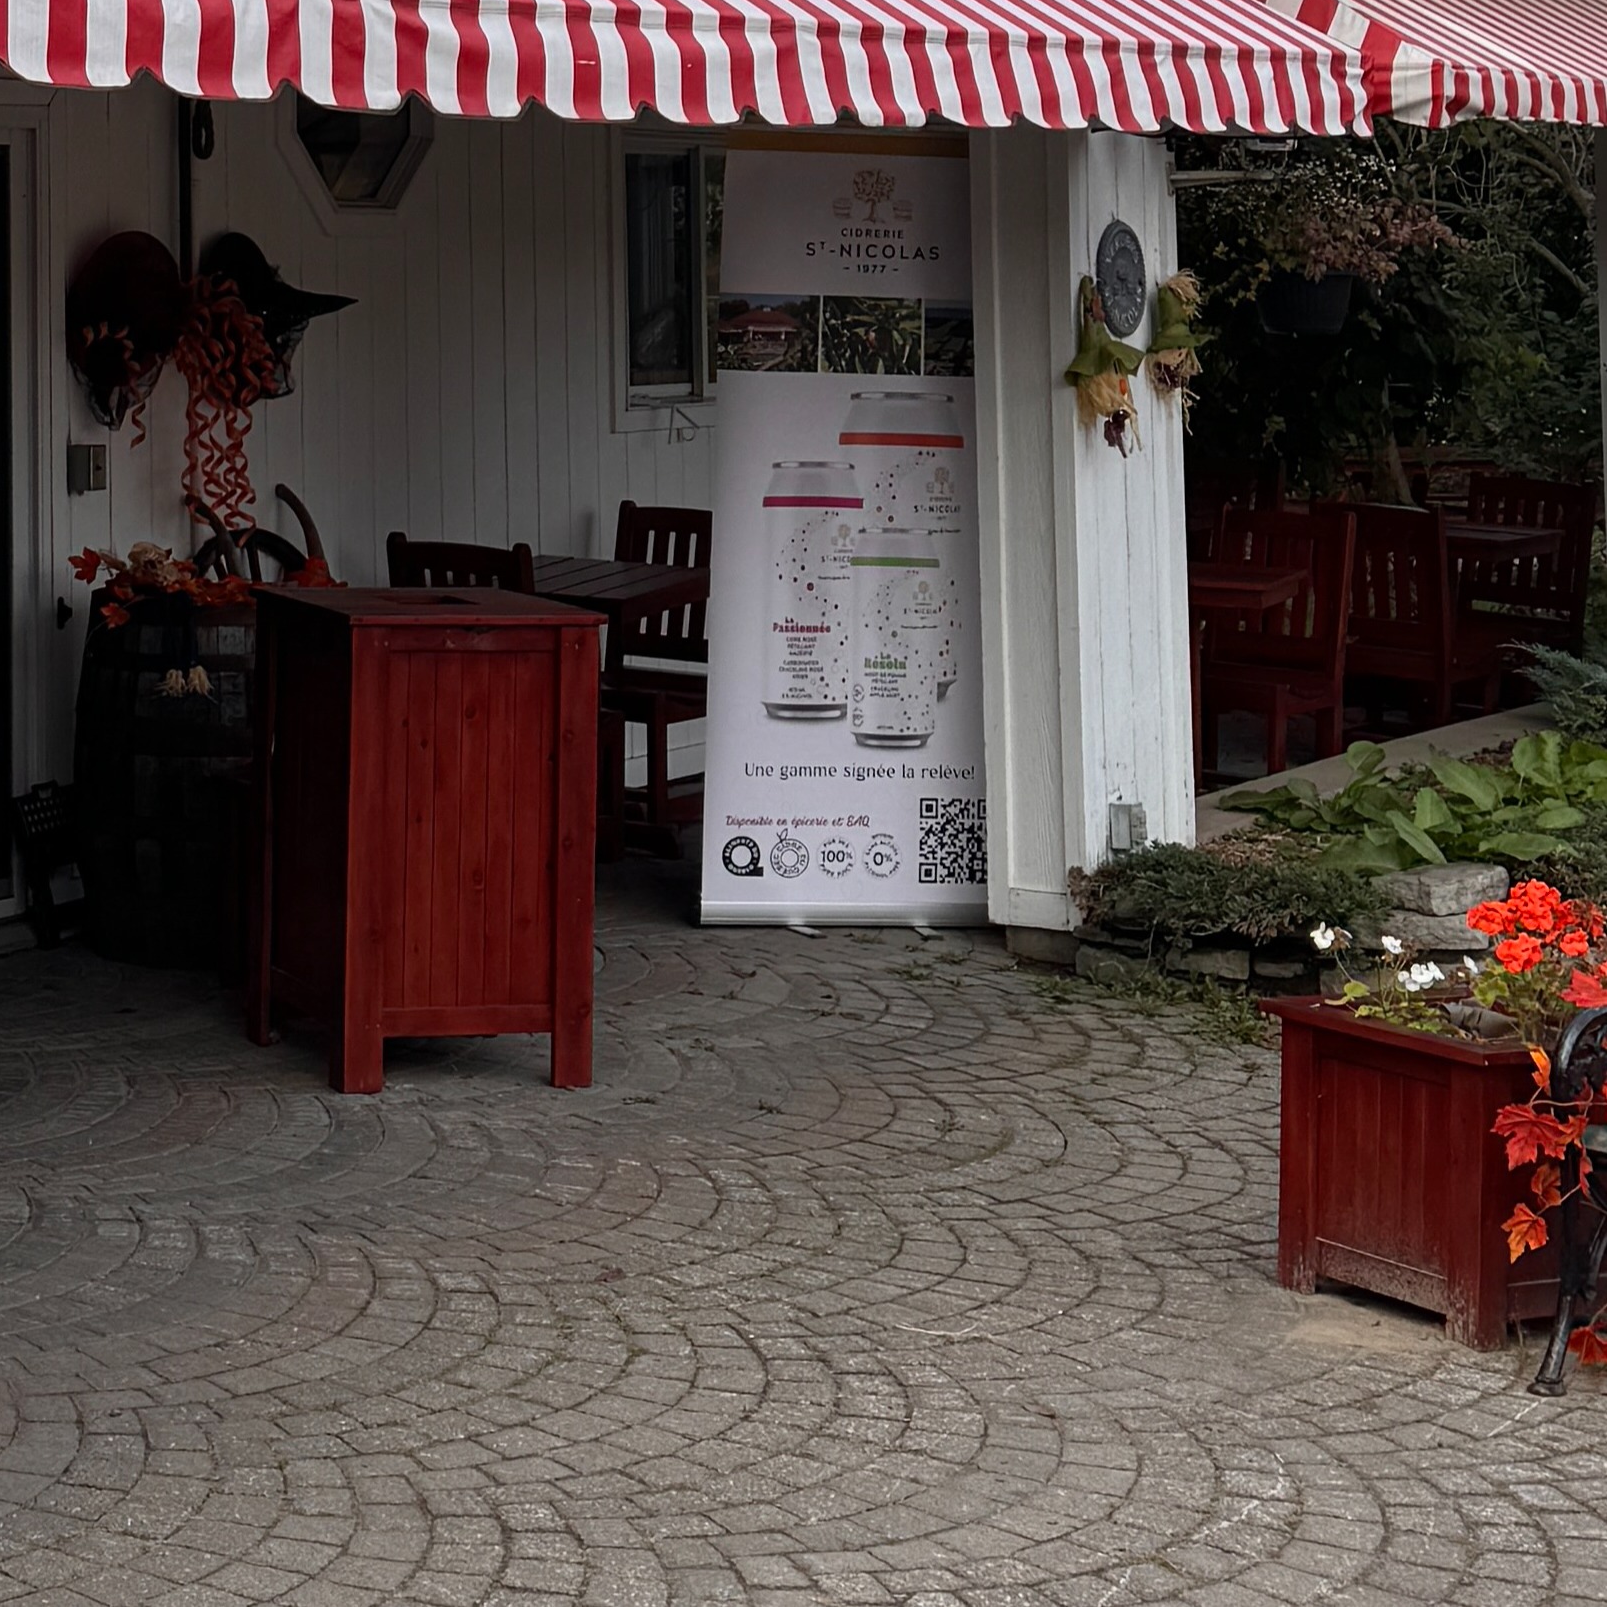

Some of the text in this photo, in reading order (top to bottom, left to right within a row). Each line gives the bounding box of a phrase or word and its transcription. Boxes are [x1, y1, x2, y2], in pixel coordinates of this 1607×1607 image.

[840, 227, 905, 240] CIDRERIE
[856, 263, 887, 274] 1977
[744, 761, 774, 778] Une
[779, 765, 837, 781] gamme
[843, 762, 896, 782] signée
[902, 763, 915, 779] la
[725, 814, 774, 829] Disponible
[776, 817, 788, 827] en
[791, 816, 828, 829] épicerie
[831, 816, 844, 827] et
